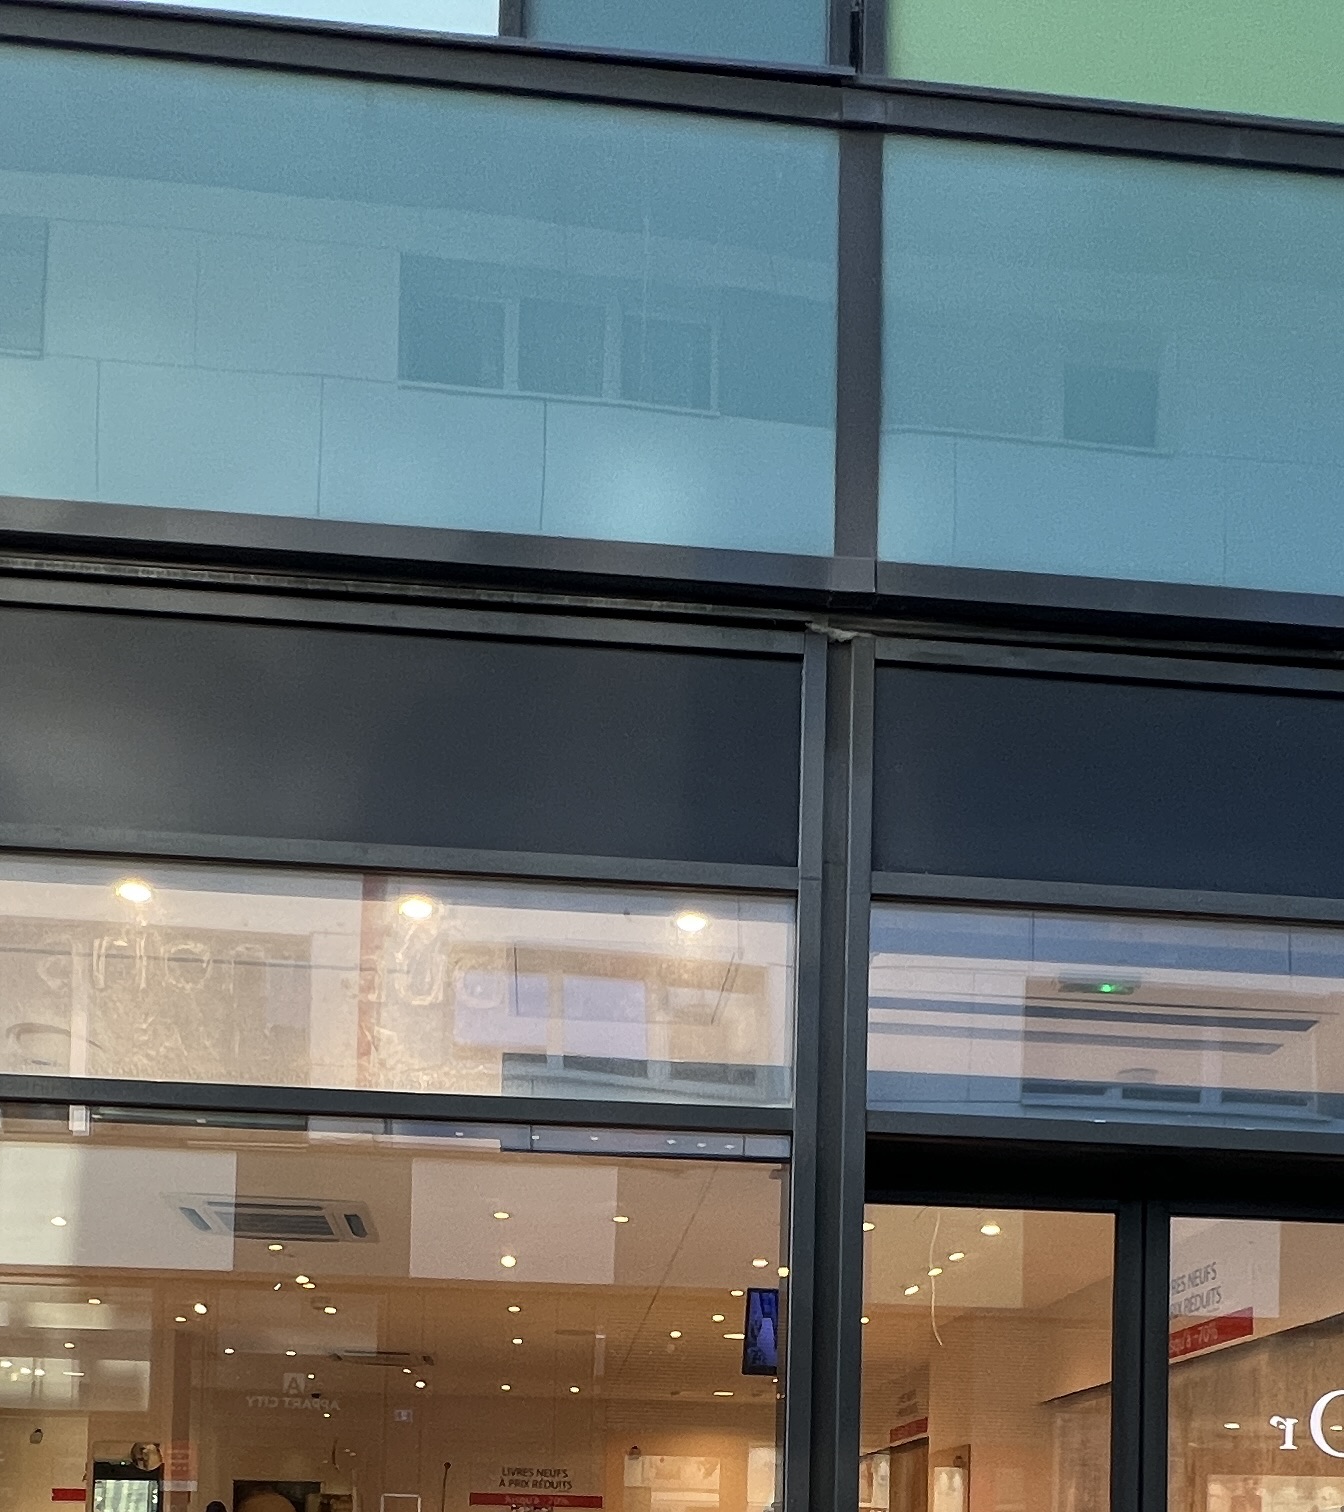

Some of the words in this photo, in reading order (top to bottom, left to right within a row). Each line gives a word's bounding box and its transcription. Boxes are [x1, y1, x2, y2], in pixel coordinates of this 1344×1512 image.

[502, 1467, 534, 1478] LIVRES
[537, 1468, 568, 1479] NEUFS
[532, 1478, 573, 1490] RÉDUITS
